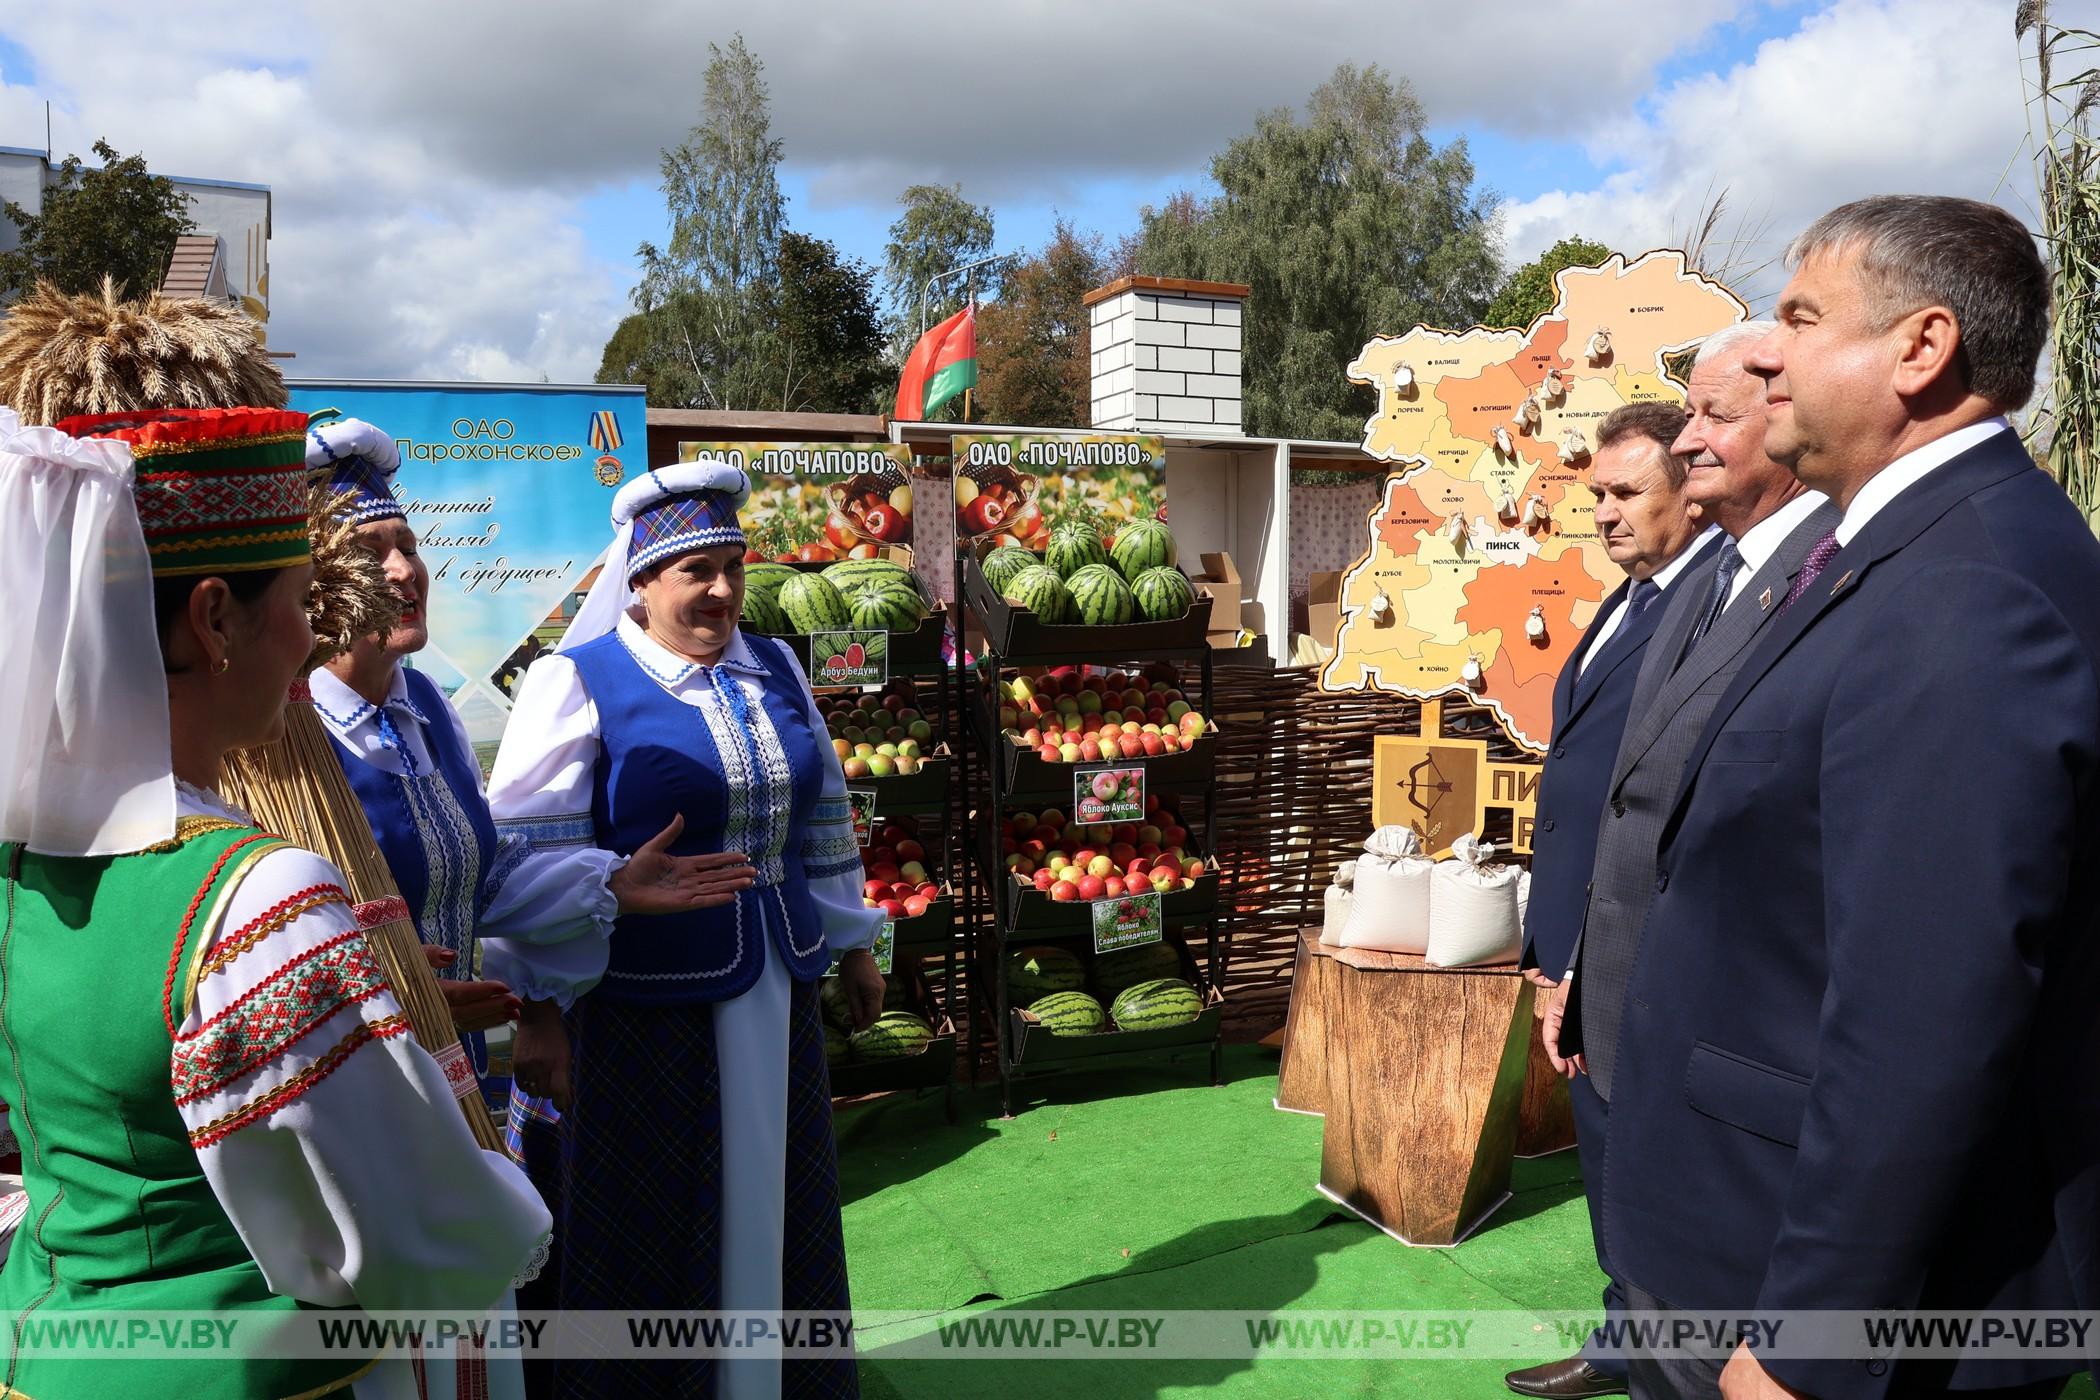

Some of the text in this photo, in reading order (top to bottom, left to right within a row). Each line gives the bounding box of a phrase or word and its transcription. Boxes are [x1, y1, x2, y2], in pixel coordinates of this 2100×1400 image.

[1434, 358, 1461, 366] ВАЛИЩЕ
[1631, 392, 1660, 400] ПОГОСТ-
[452, 418, 515, 440] ОАО
[751, 450, 898, 475] «ПОЧАПОВО»
[969, 441, 1152, 467] ОАО «ПОЧАПОВО»
[392, 483, 497, 516] еренный
[418, 522, 500, 548] взгляд
[1486, 541, 1521, 551] ПИНСК
[433, 555, 573, 594] в будущее!
[1531, 588, 1566, 596] ПЛЕЩИЦЫ
[820, 666, 879, 678] Арбуз Бедуин
[1082, 802, 1138, 814] Яблоко Ауксис
